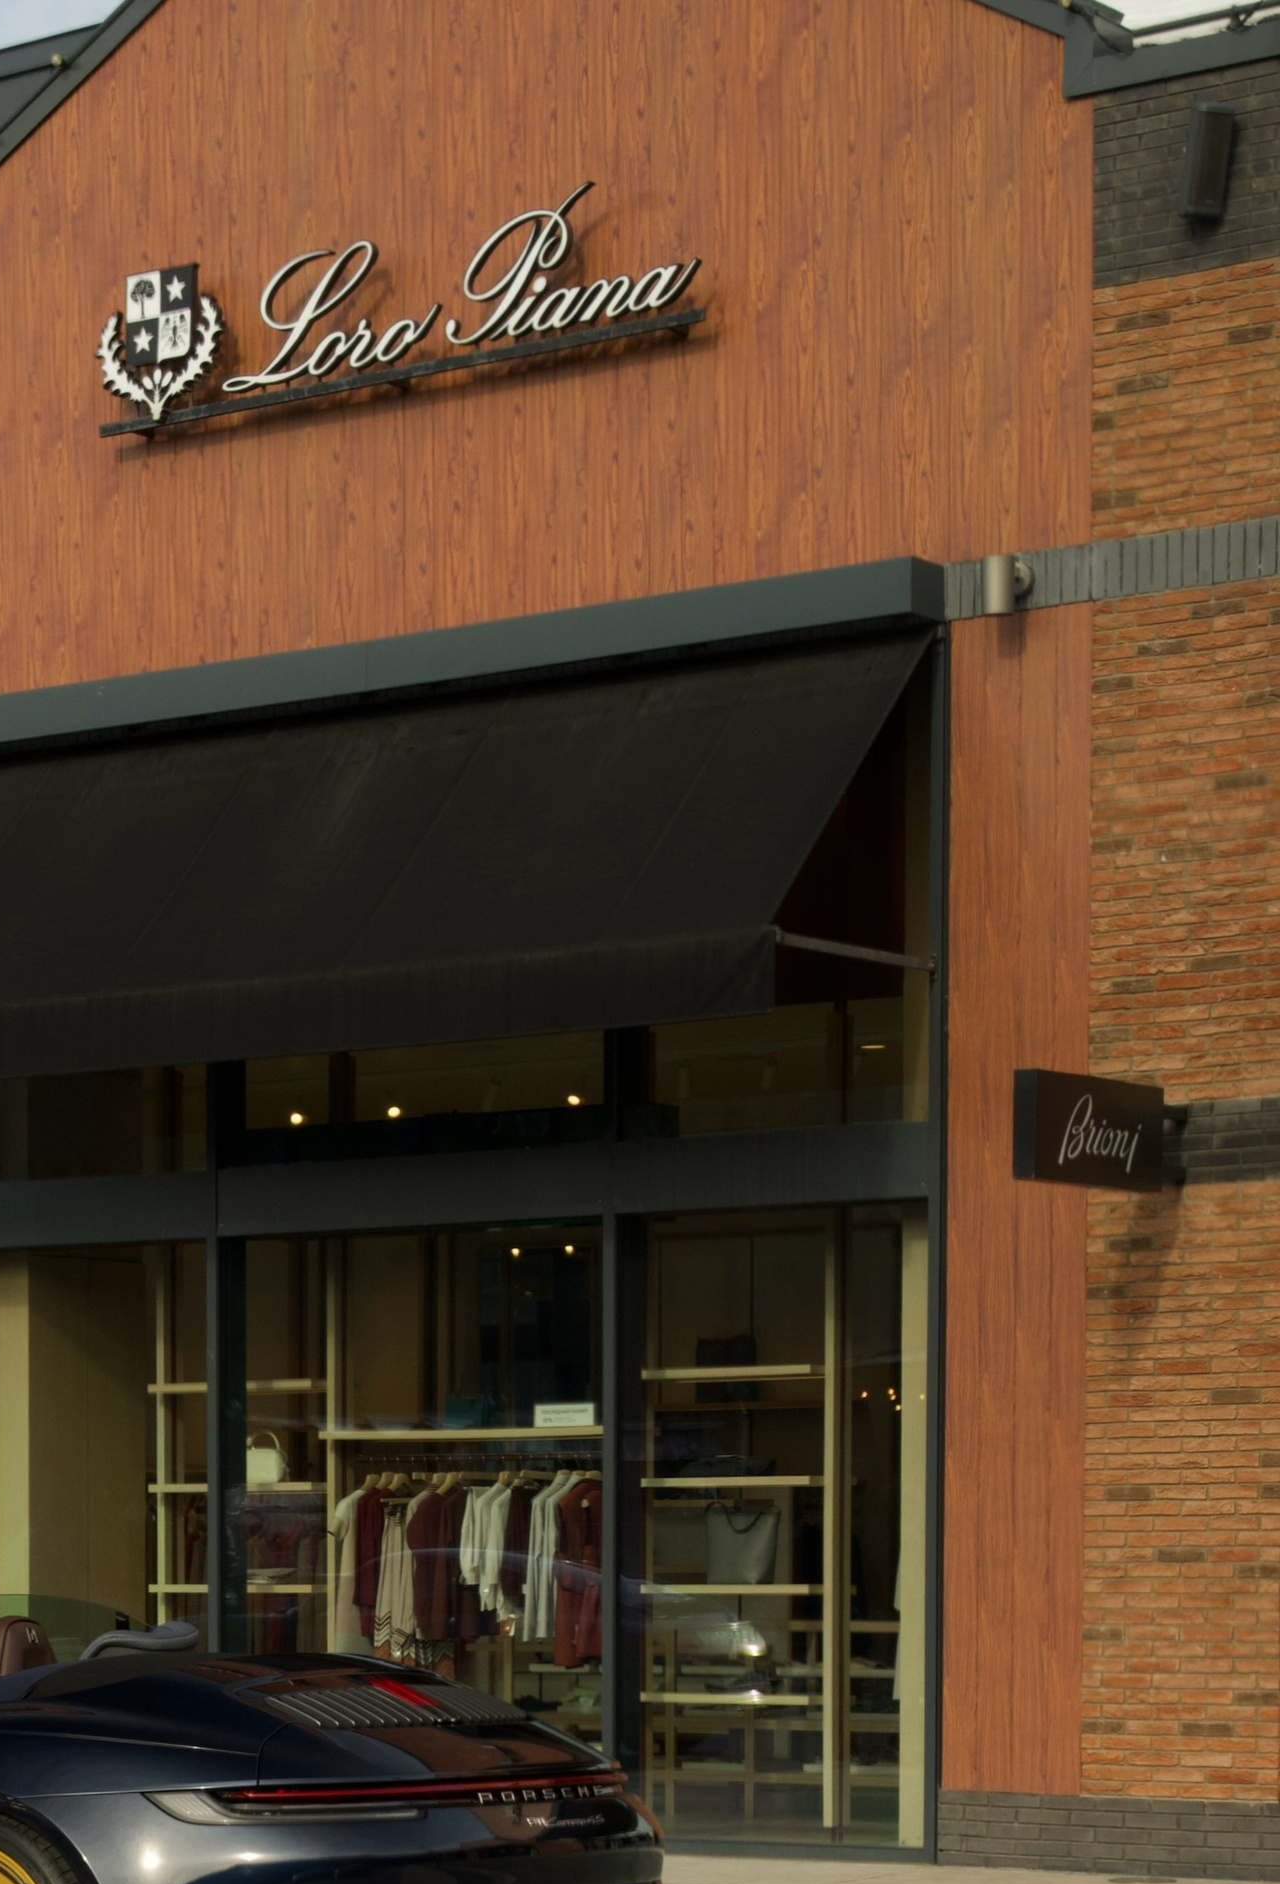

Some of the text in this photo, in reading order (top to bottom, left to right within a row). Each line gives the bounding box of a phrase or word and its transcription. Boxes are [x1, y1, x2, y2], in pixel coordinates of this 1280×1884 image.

[221, 180, 702, 392] Loro Piana
[1057, 1094, 1142, 1174] Brioni
[477, 1785, 604, 1805] PORSCHE
